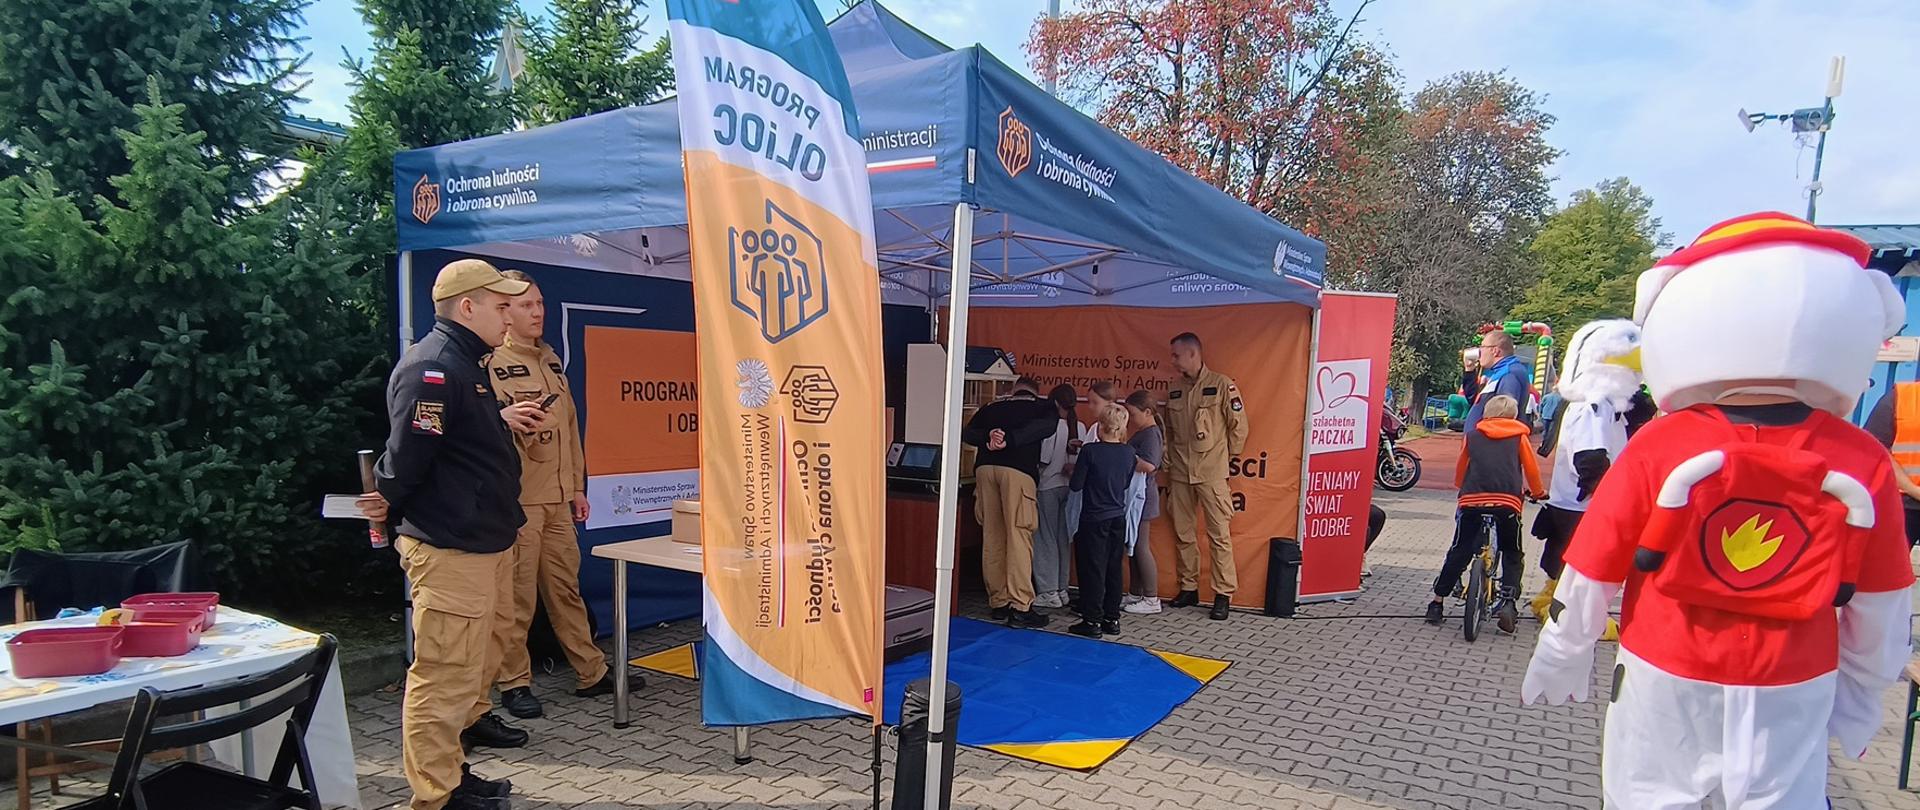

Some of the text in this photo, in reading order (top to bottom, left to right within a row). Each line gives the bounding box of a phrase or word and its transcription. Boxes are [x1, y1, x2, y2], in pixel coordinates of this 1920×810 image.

[446, 163, 540, 194] Ochrona ludności
[1036, 154, 1043, 175] i
[1043, 158, 1081, 189] obrona
[1075, 153, 1117, 188] ludności
[446, 187, 538, 213] i obrona cywilna
[1022, 353, 1159, 371] Ministerstwo Spraw
[1126, 375, 1130, 389] i
[668, 413, 672, 433] I
[1312, 416, 1356, 428] szlachetna
[1311, 429, 1354, 445] PACZKA
[632, 482, 696, 495] Ministerstwo Spraw
[1305, 491, 1343, 515] ŚWIAT
[1311, 517, 1353, 538] DOBRE
